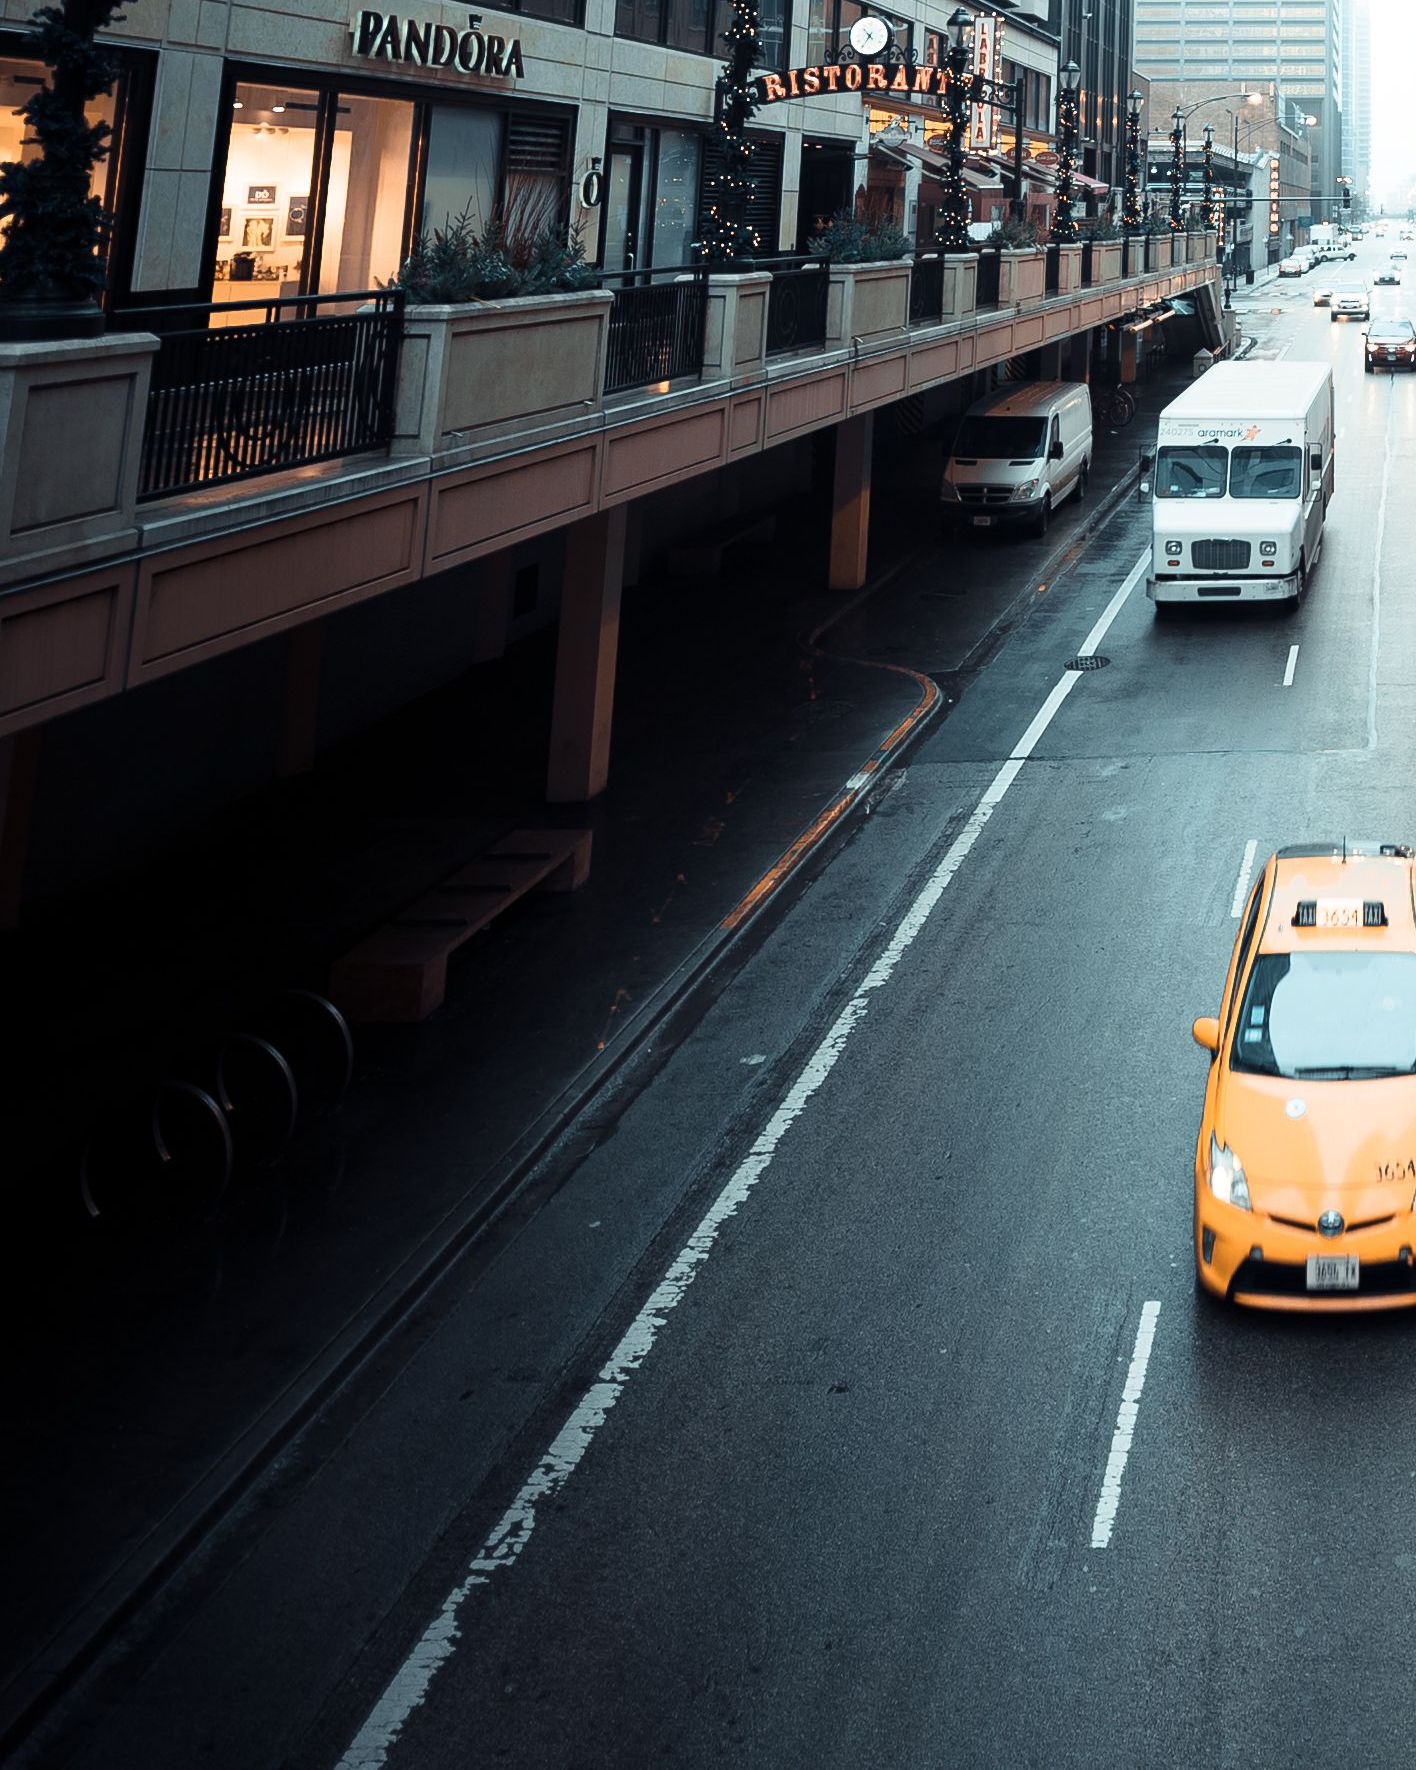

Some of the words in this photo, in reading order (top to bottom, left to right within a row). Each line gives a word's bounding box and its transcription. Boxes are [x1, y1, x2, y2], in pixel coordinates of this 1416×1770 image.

[352, 10, 525, 79] PANDORA
[975, 22, 989, 140] LABROLA
[1197, 428, 1243, 438] aramark
[1299, 904, 1316, 926] TAXI
[1364, 904, 1381, 926] TAXI
